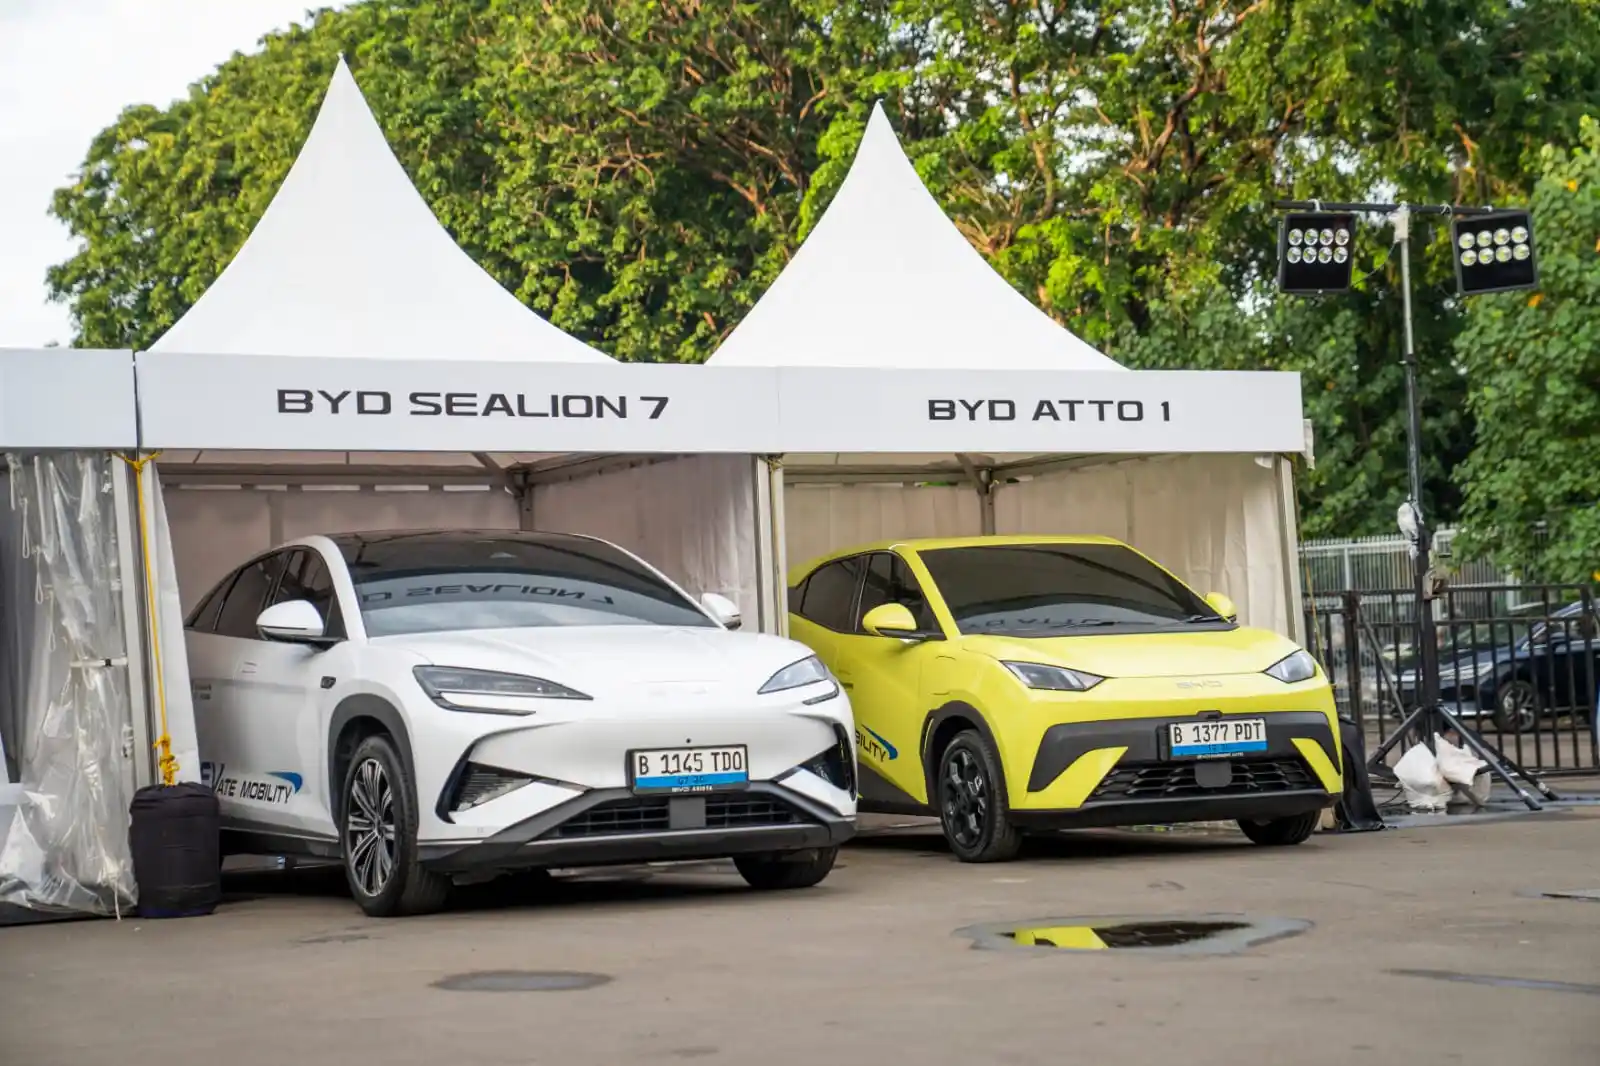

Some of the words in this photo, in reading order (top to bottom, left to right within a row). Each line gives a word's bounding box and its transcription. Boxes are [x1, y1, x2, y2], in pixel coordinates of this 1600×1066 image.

[277, 389, 392, 415] BYD
[408, 391, 627, 419] SEALION
[639, 396, 669, 420] 7
[928, 399, 1016, 421] BYD
[1031, 399, 1144, 422] ATTO
[1160, 401, 1170, 422] 1
[1173, 726, 1183, 744] B
[1192, 723, 1229, 743] 1377
[1234, 722, 1262, 741] PDT
[638, 755, 649, 775] B
[660, 752, 703, 774] 1145
[710, 751, 742, 772] TDO
[240, 780, 293, 804] MOBILITY
